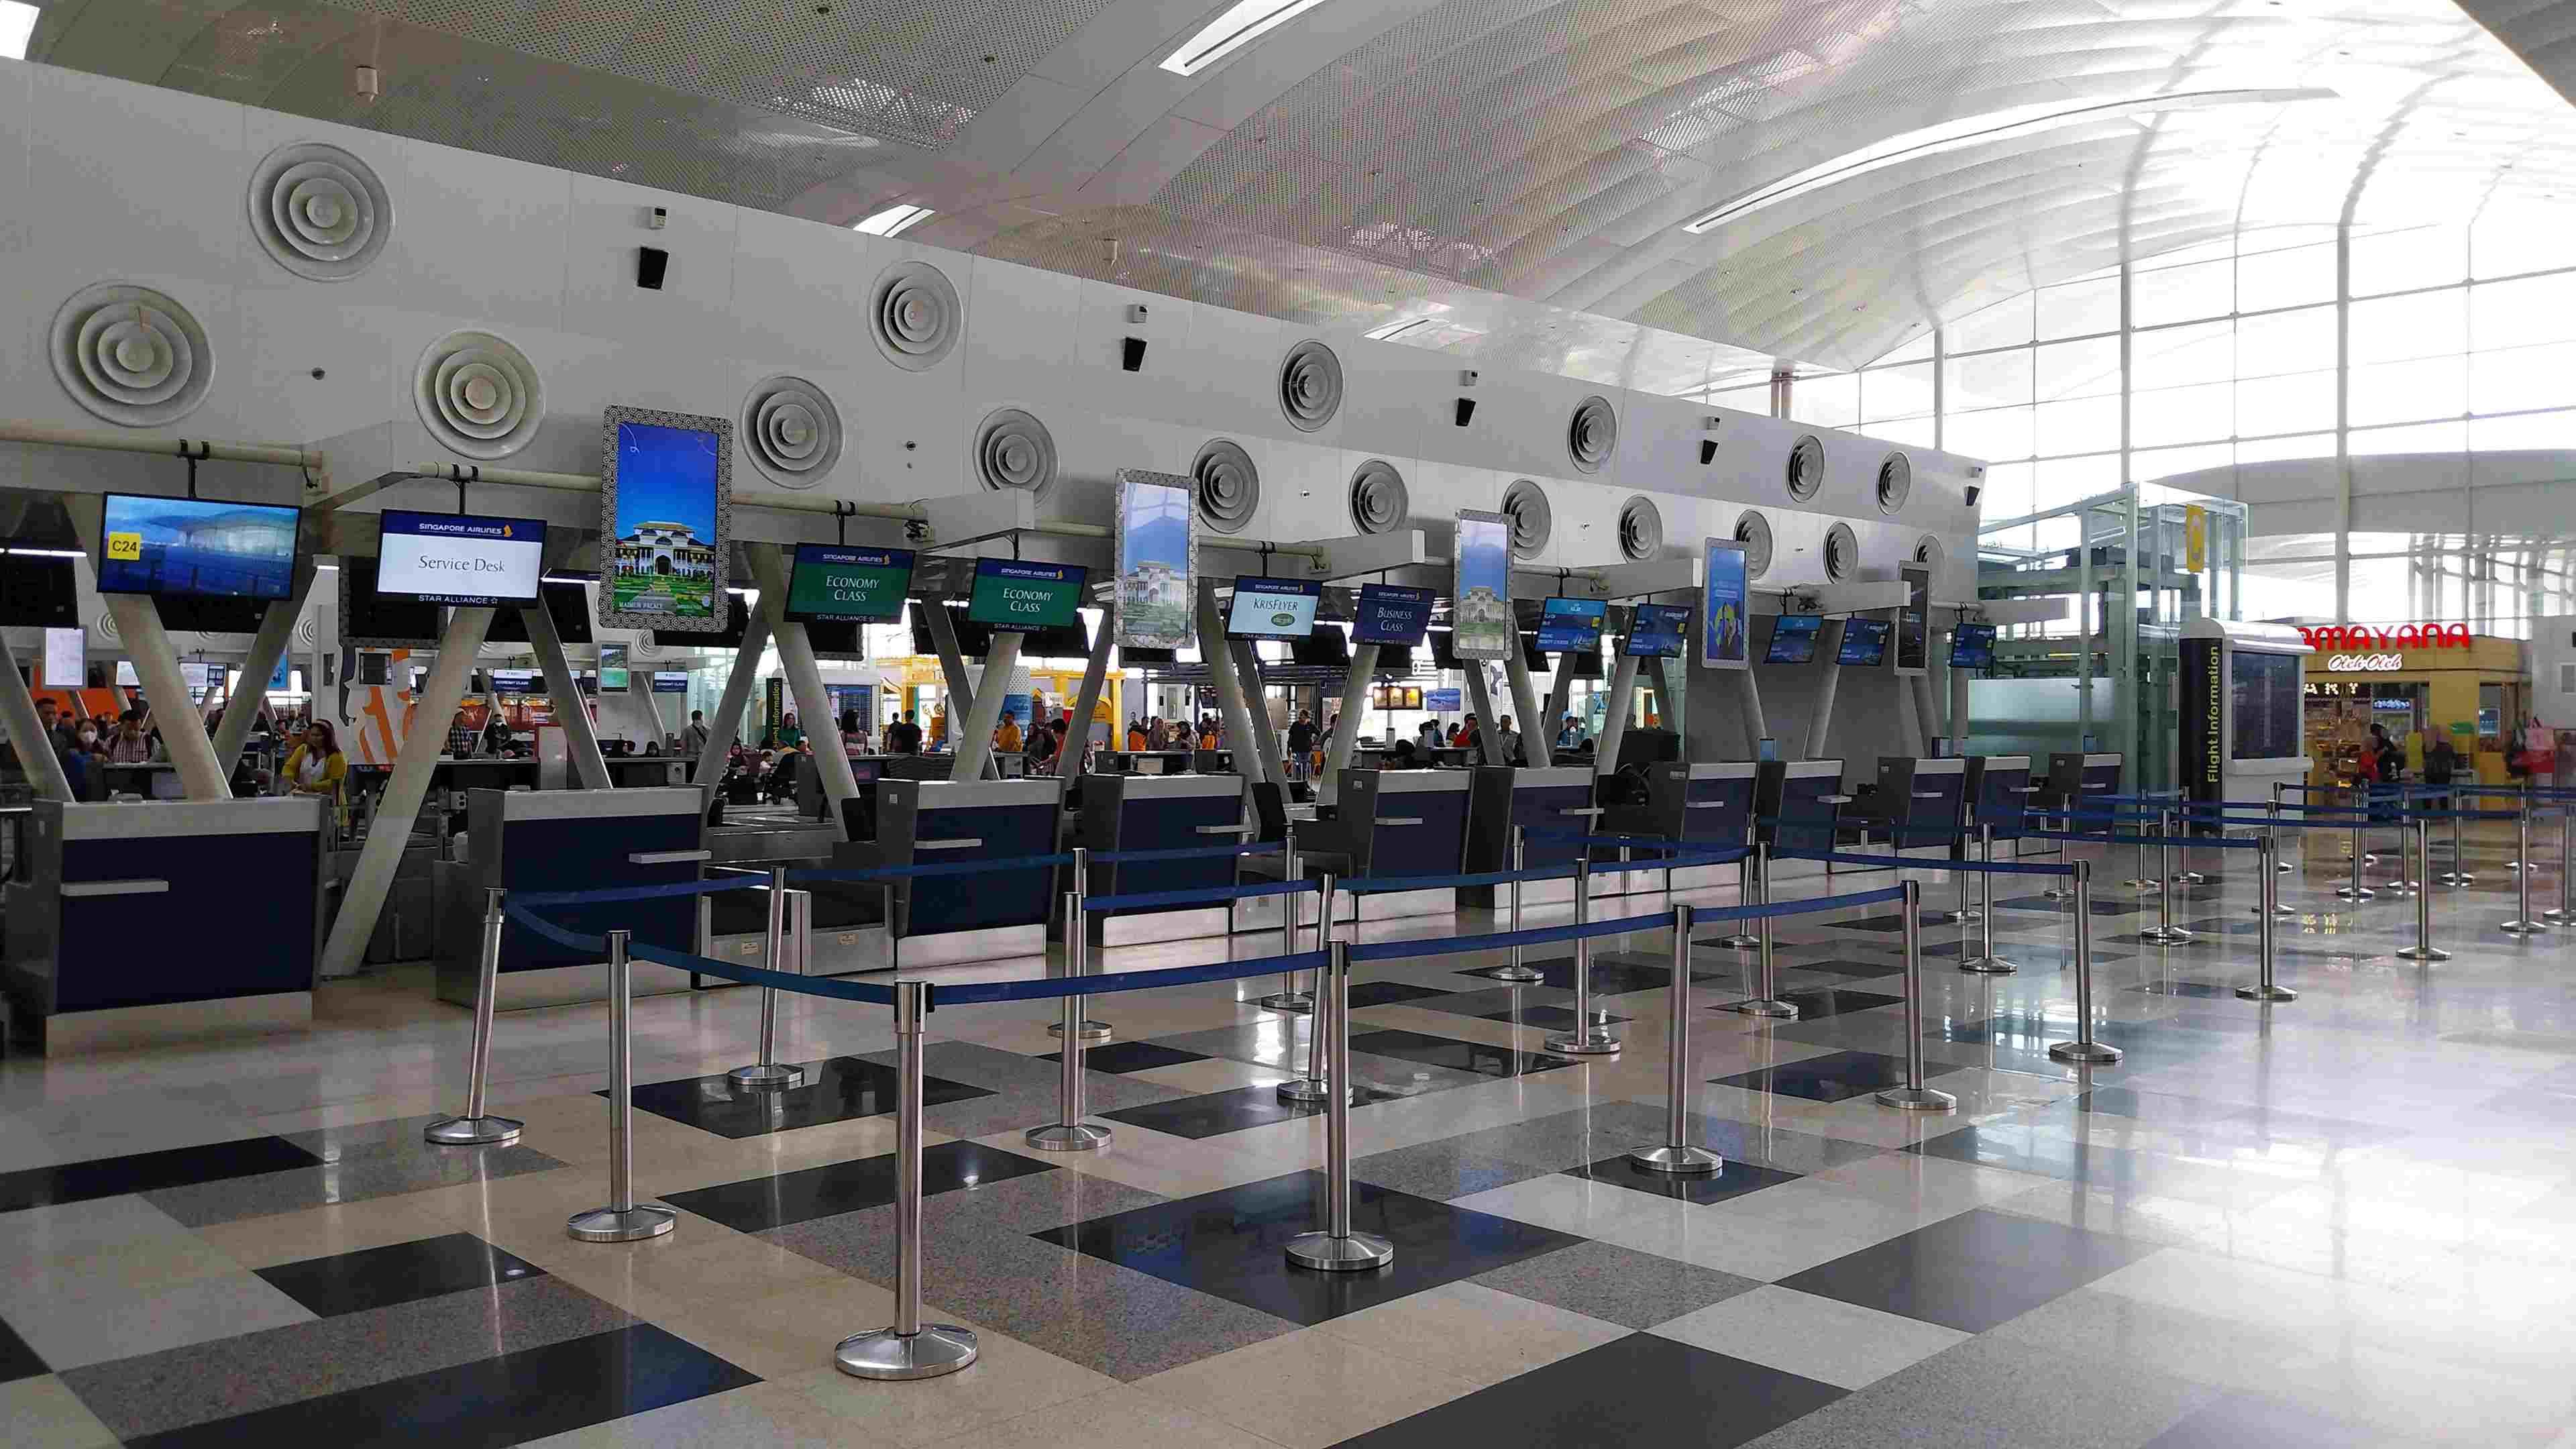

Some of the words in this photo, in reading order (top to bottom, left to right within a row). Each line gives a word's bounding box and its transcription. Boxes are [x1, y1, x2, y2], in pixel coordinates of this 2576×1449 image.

[419, 523, 465, 532] SINGAPORE
[467, 526, 502, 534] AIRLINES
[112, 539, 138, 552] C24
[419, 555, 470, 570] Service
[474, 559, 504, 572] Desk
[822, 553, 856, 561] SINGAPORE
[826, 576, 880, 589] ECONOMY
[444, 596, 488, 604] ALLIANCE
[834, 590, 867, 602] CLASS
[1003, 588, 1054, 601] ECONOMY
[1010, 601, 1041, 612] CLASS
[1377, 606, 1412, 619] BUSINESS
[1381, 619, 1403, 631] CLASS
[2208, 646, 2218, 735] Information
[772, 681, 780, 725] Information
[2208, 739, 2220, 783] Flight
